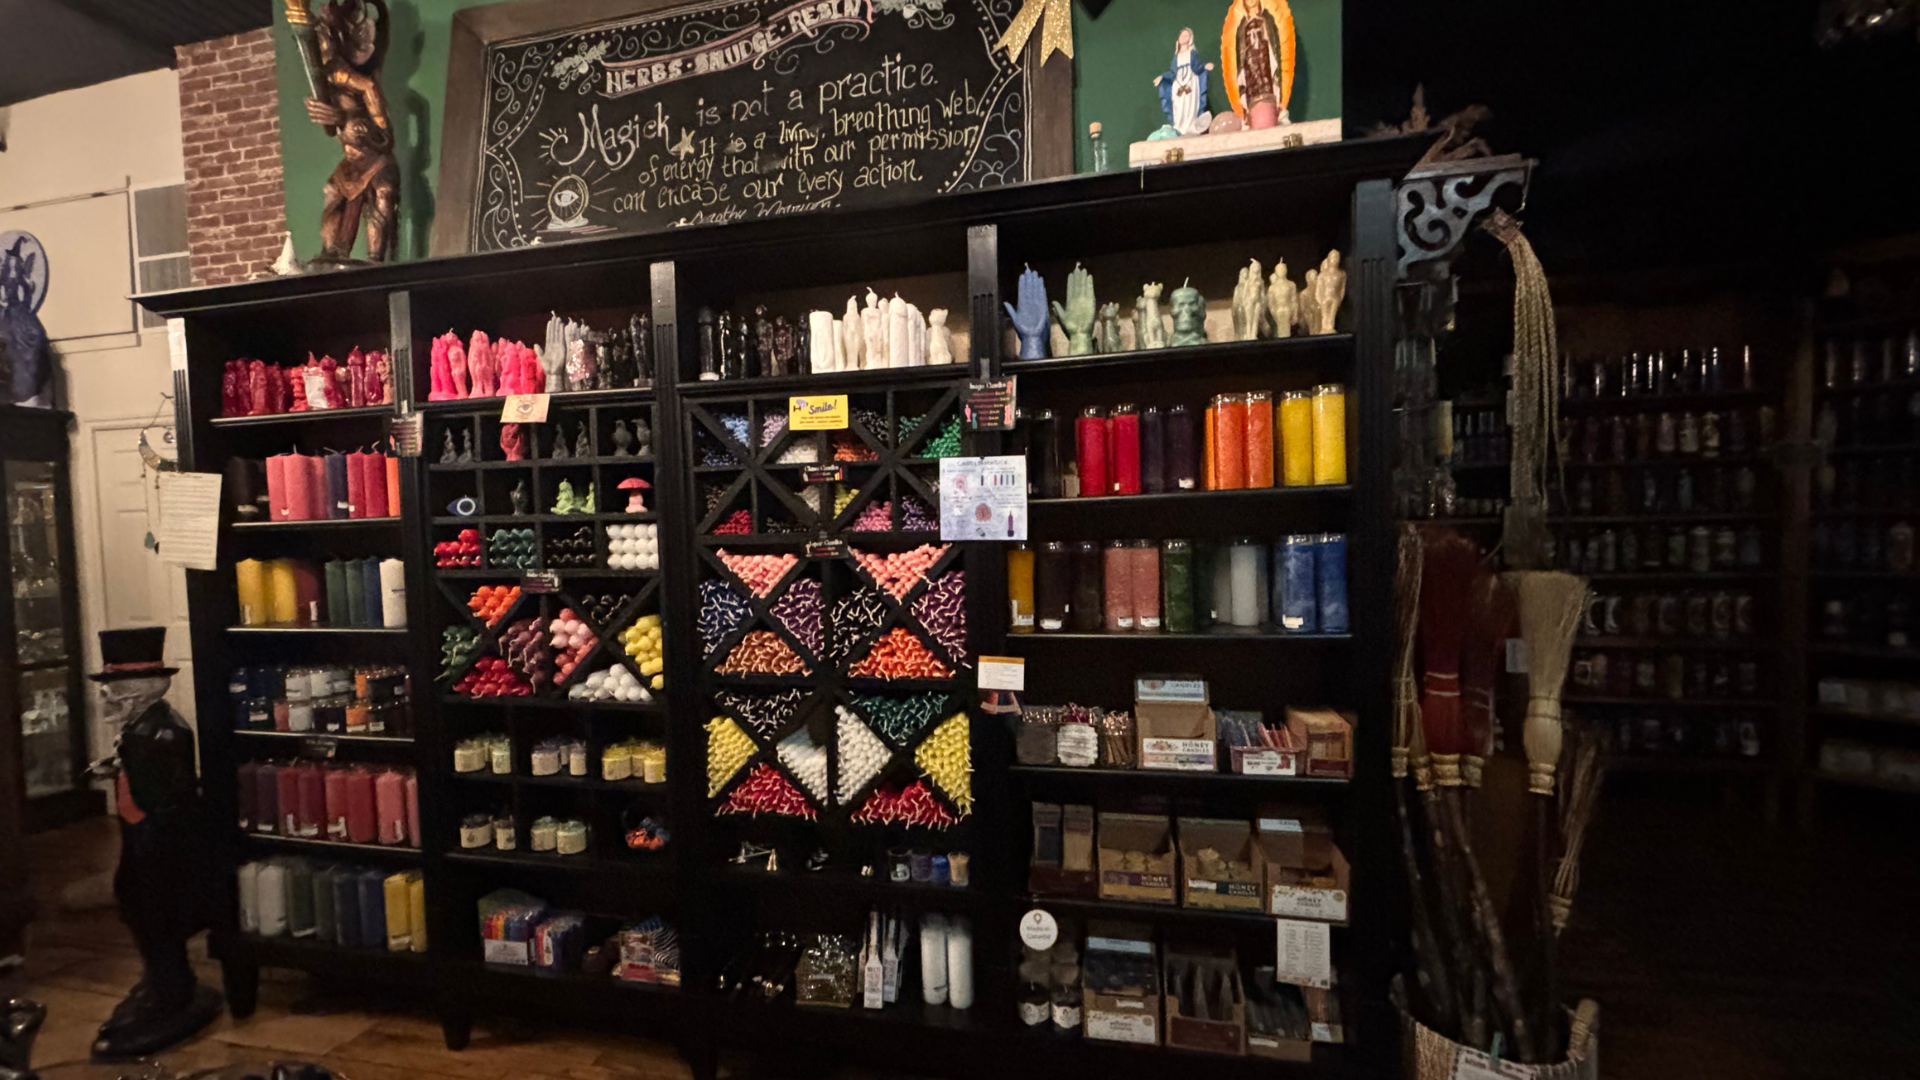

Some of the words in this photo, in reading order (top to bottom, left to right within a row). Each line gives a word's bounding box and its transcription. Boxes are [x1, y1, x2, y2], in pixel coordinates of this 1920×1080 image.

[606, 60, 682, 93] HERBS
[550, 103, 674, 171] Magick
[697, 98, 721, 126] is
[732, 80, 774, 121] not
[788, 90, 804, 111] a
[819, 53, 938, 114] practice.
[699, 136, 715, 158] It
[729, 133, 747, 154] is
[753, 131, 766, 150] a
[829, 98, 931, 136] breathing
[935, 78, 977, 119] web
[638, 155, 660, 187] of
[662, 153, 715, 184] energy
[721, 151, 760, 178] that
[824, 140, 855, 164] our
[868, 122, 979, 163] permission
[613, 191, 647, 213] can
[657, 181, 731, 209] encase
[743, 173, 784, 199] our
[798, 169, 844, 201] every
[853, 158, 925, 190] action.
[808, 399, 837, 415] Smile!
[1228, 883, 1257, 892] HONEY
